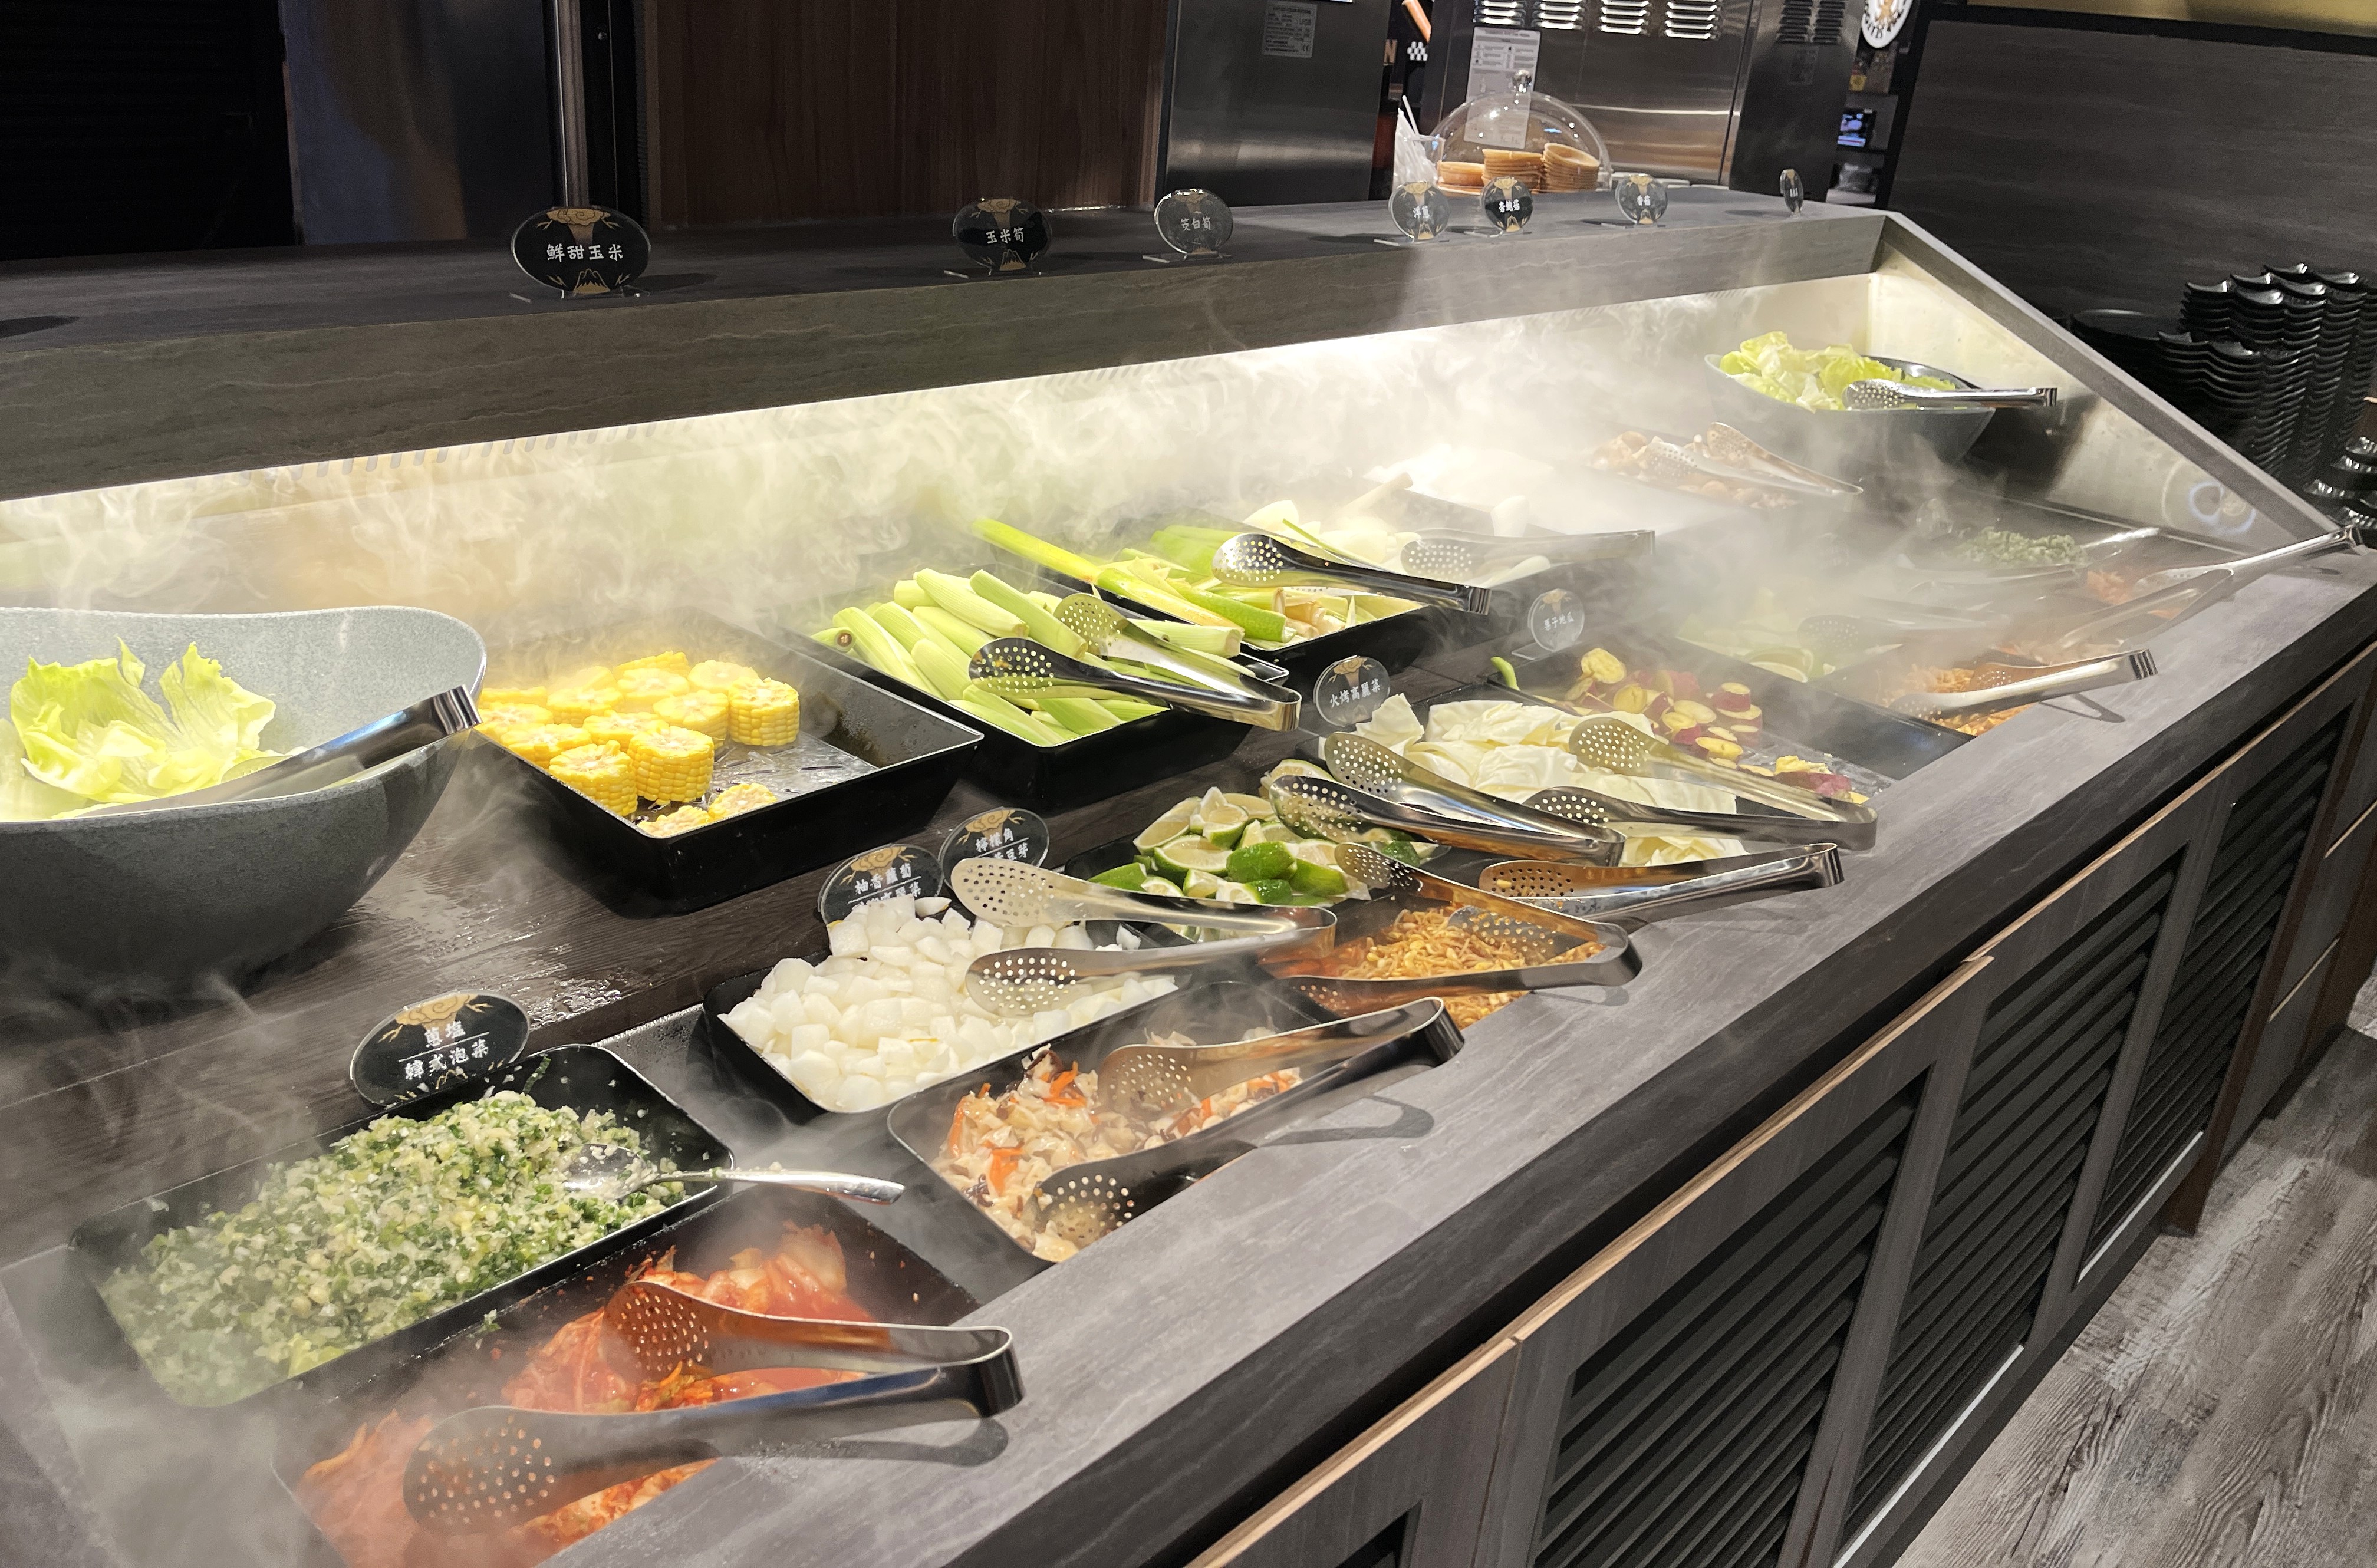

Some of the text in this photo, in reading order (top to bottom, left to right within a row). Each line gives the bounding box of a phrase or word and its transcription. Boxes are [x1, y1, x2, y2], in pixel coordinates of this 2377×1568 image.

[986, 226, 1024, 245] 玉米筍
[546, 243, 624, 263] 鮮甜玉米
[1330, 678, 1381, 709] 火烤高麗菜
[975, 827, 1014, 853] 檸檬角
[855, 862, 912, 895] 柚香蘿蔔
[404, 1039, 489, 1081] 韓式泡菜
